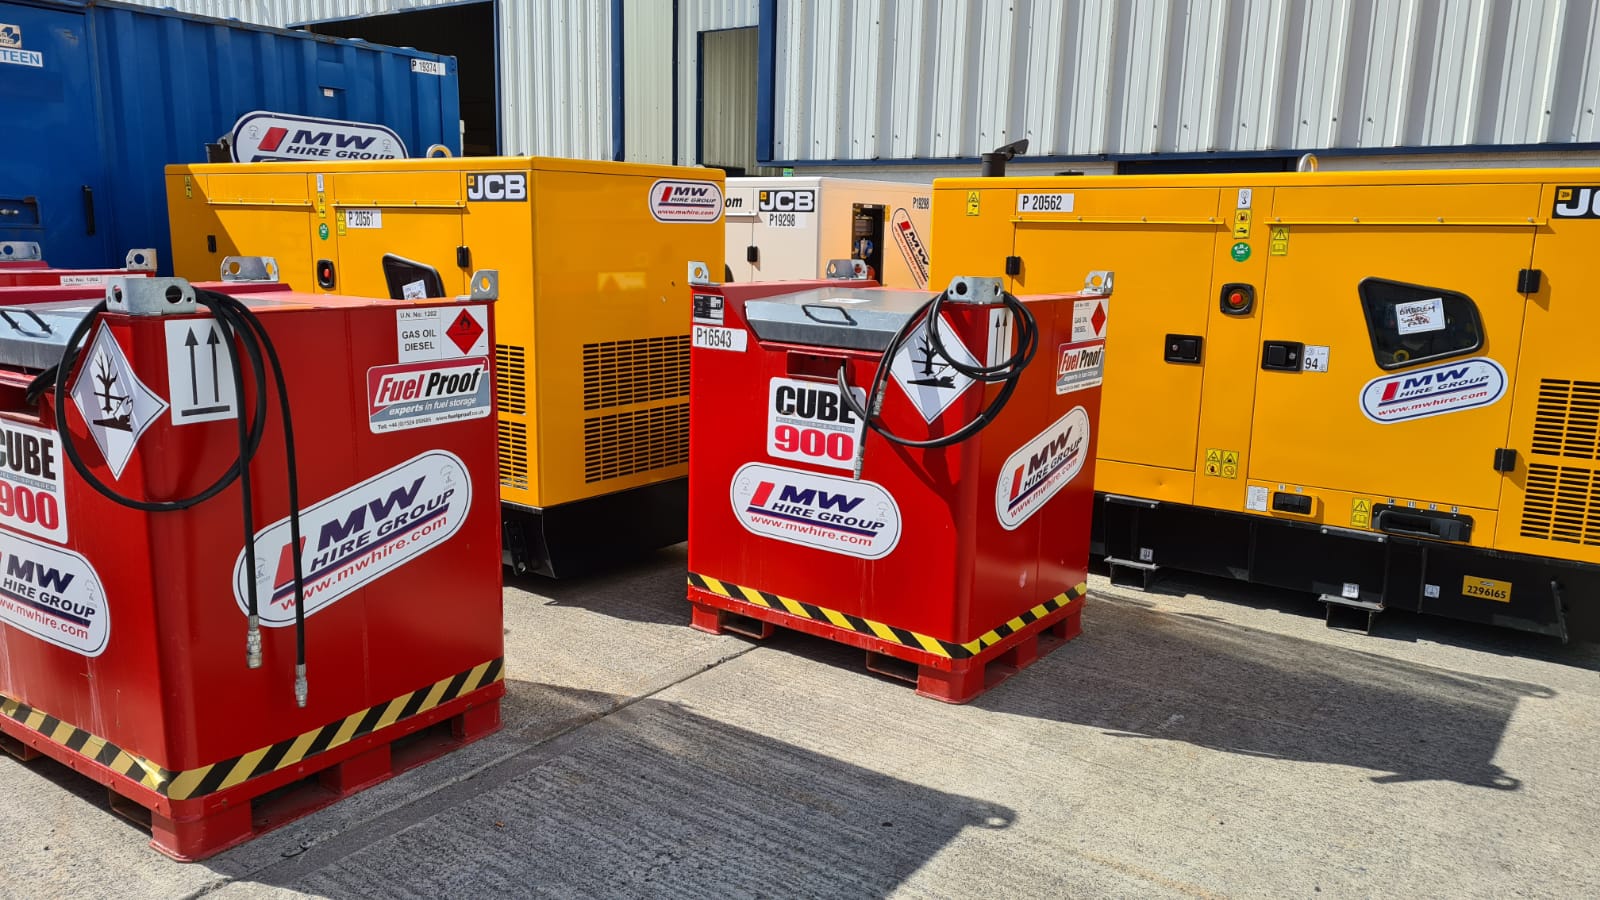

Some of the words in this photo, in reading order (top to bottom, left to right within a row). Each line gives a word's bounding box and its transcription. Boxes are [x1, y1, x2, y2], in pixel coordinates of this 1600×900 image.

[286, 145, 330, 157] HIRE
[291, 129, 377, 150] MW
[467, 174, 526, 200] JCB
[674, 186, 709, 197] MW
[760, 191, 814, 211] JCB
[1022, 195, 1030, 210] P
[1032, 194, 1063, 210] 20562
[1556, 188, 1600, 217] J
[348, 210, 354, 226] P
[355, 210, 374, 227] 20561
[769, 213, 796, 227] P19298
[401, 330, 421, 340] GAS
[422, 329, 437, 338] OIL
[404, 341, 435, 352] DIESEL
[696, 327, 732, 348] P16543
[1061, 350, 1080, 373] Fuel
[1079, 346, 1102, 369] Proof
[1305, 357, 1319, 370] 94
[377, 373, 426, 403] Fuel
[425, 367, 481, 397] Proof
[1400, 386, 1433, 398] HIRE
[1437, 375, 1490, 391] GROUP
[1403, 366, 1471, 390] MW
[389, 404, 424, 416] experts
[434, 399, 448, 409] fuel
[449, 396, 477, 408] storage
[775, 385, 856, 425] CUBE
[1377, 390, 1488, 417] www.mwhire.com
[774, 424, 854, 462] 900
[1027, 425, 1073, 477] MW
[1023, 463, 1049, 491] HIRE
[1050, 436, 1083, 469] GROUP
[779, 484, 865, 513] MW
[1010, 457, 1078, 518] www.mwhire.com
[0, 479, 59, 530] 900
[317, 475, 427, 552] MW
[771, 502, 815, 518] HIRE
[817, 511, 886, 531] GROUP
[310, 530, 372, 573] HIRE
[377, 488, 455, 538] GROUP
[750, 515, 873, 547] www.mwhire.com
[6, 553, 75, 594] MW
[3, 577, 37, 599] HIRE
[39, 591, 96, 618] GROUP
[1467, 584, 1507, 599] 2296165
